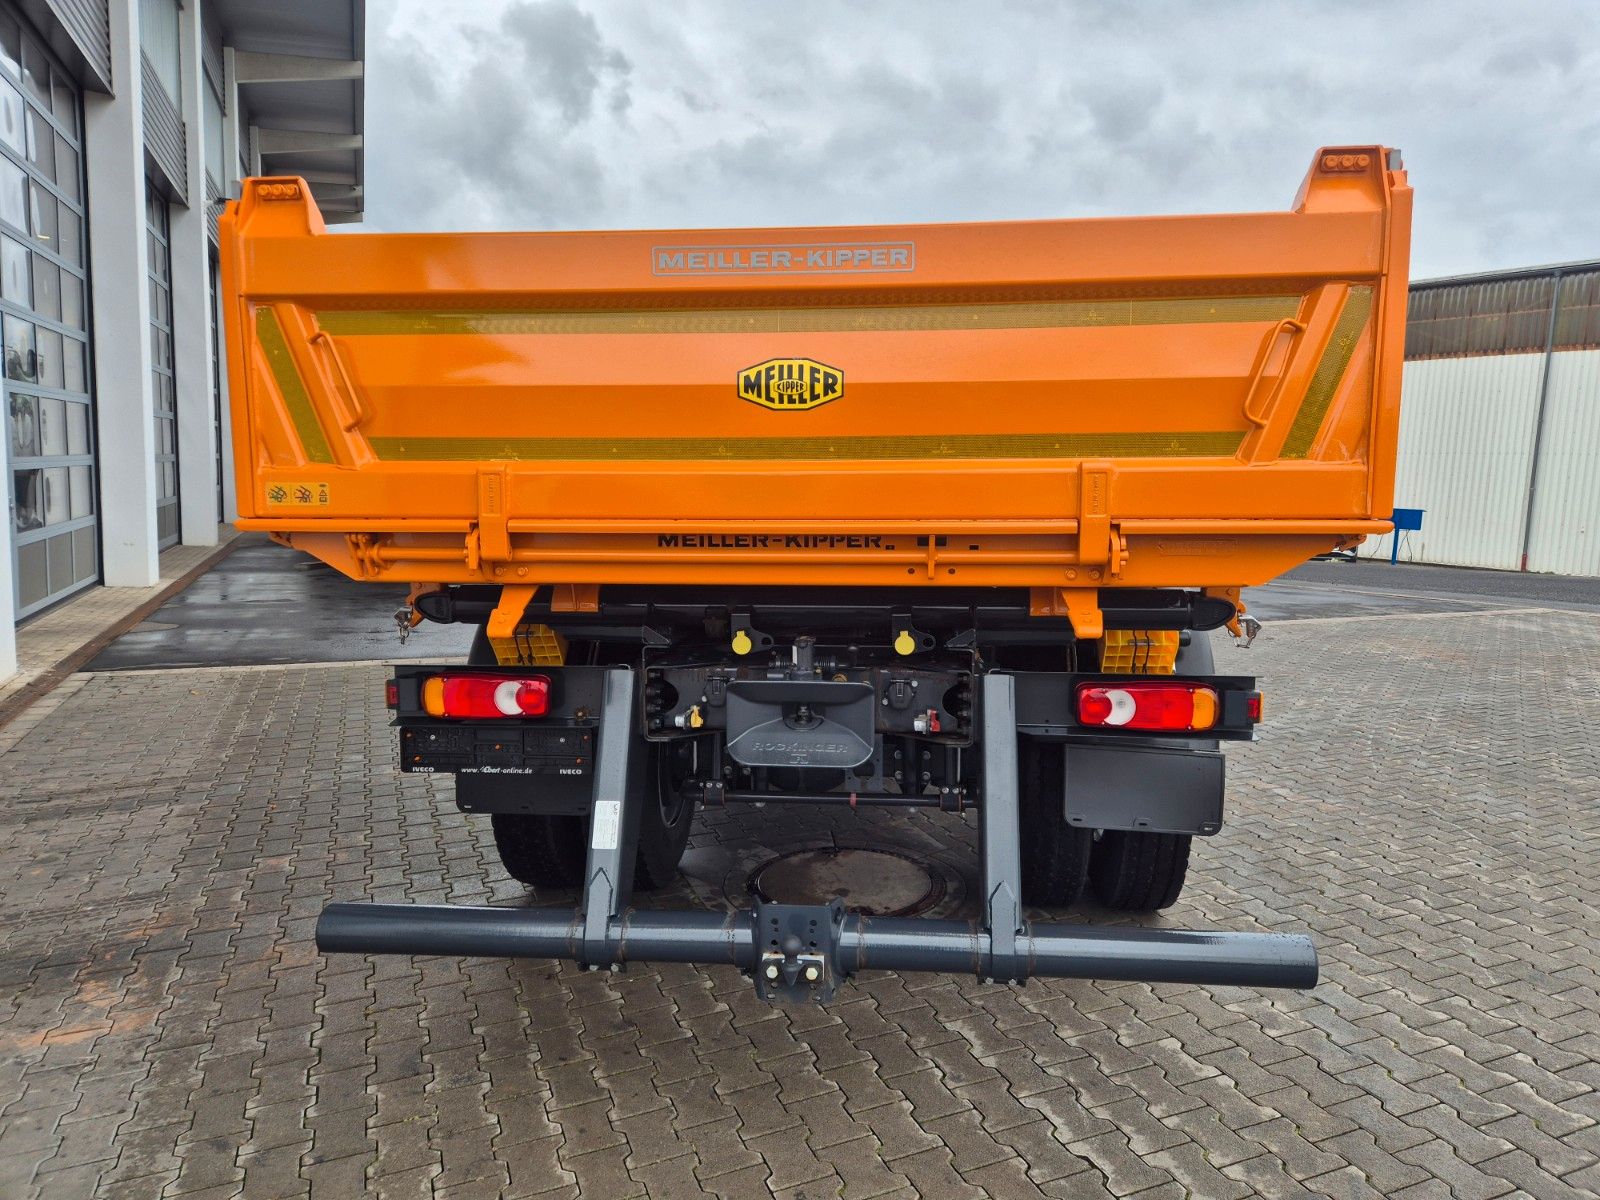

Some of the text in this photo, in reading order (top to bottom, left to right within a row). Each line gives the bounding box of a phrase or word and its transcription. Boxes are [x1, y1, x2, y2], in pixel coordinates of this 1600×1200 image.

[658, 249, 908, 269] MEILLER-KIPPER
[743, 364, 839, 404] MEILLER
[776, 380, 805, 394] KIPPER
[657, 534, 882, 548] MEILLER-KIPPER
